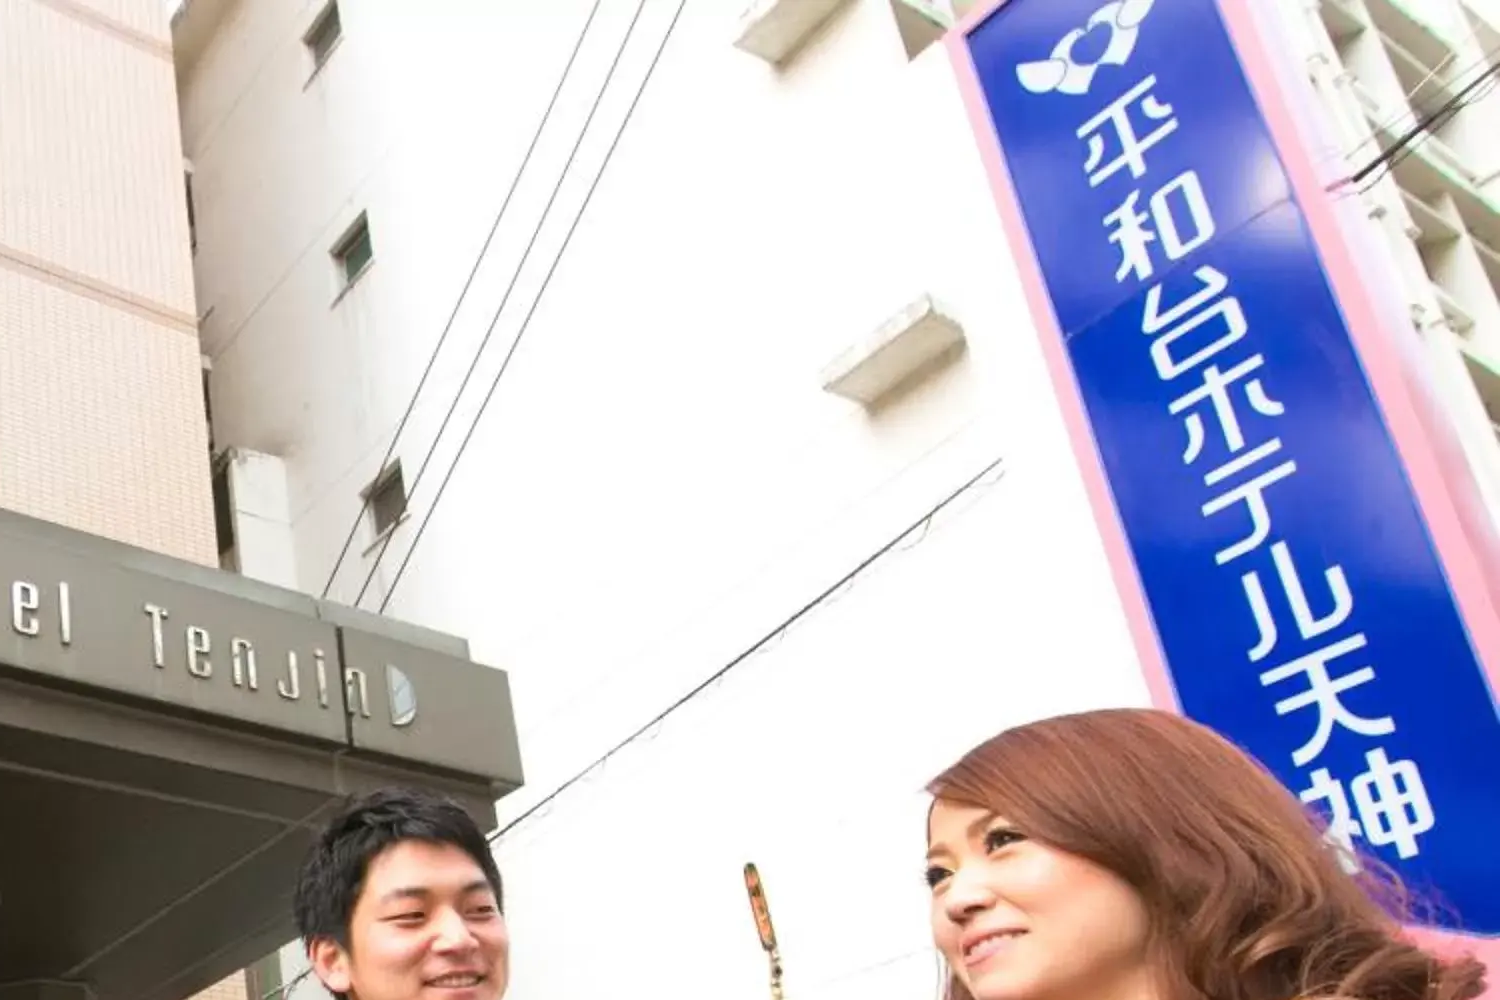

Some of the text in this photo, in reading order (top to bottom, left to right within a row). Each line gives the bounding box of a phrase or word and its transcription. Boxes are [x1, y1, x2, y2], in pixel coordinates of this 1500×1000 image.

[1075, 73, 1436, 875] 平和台ホテル天神
